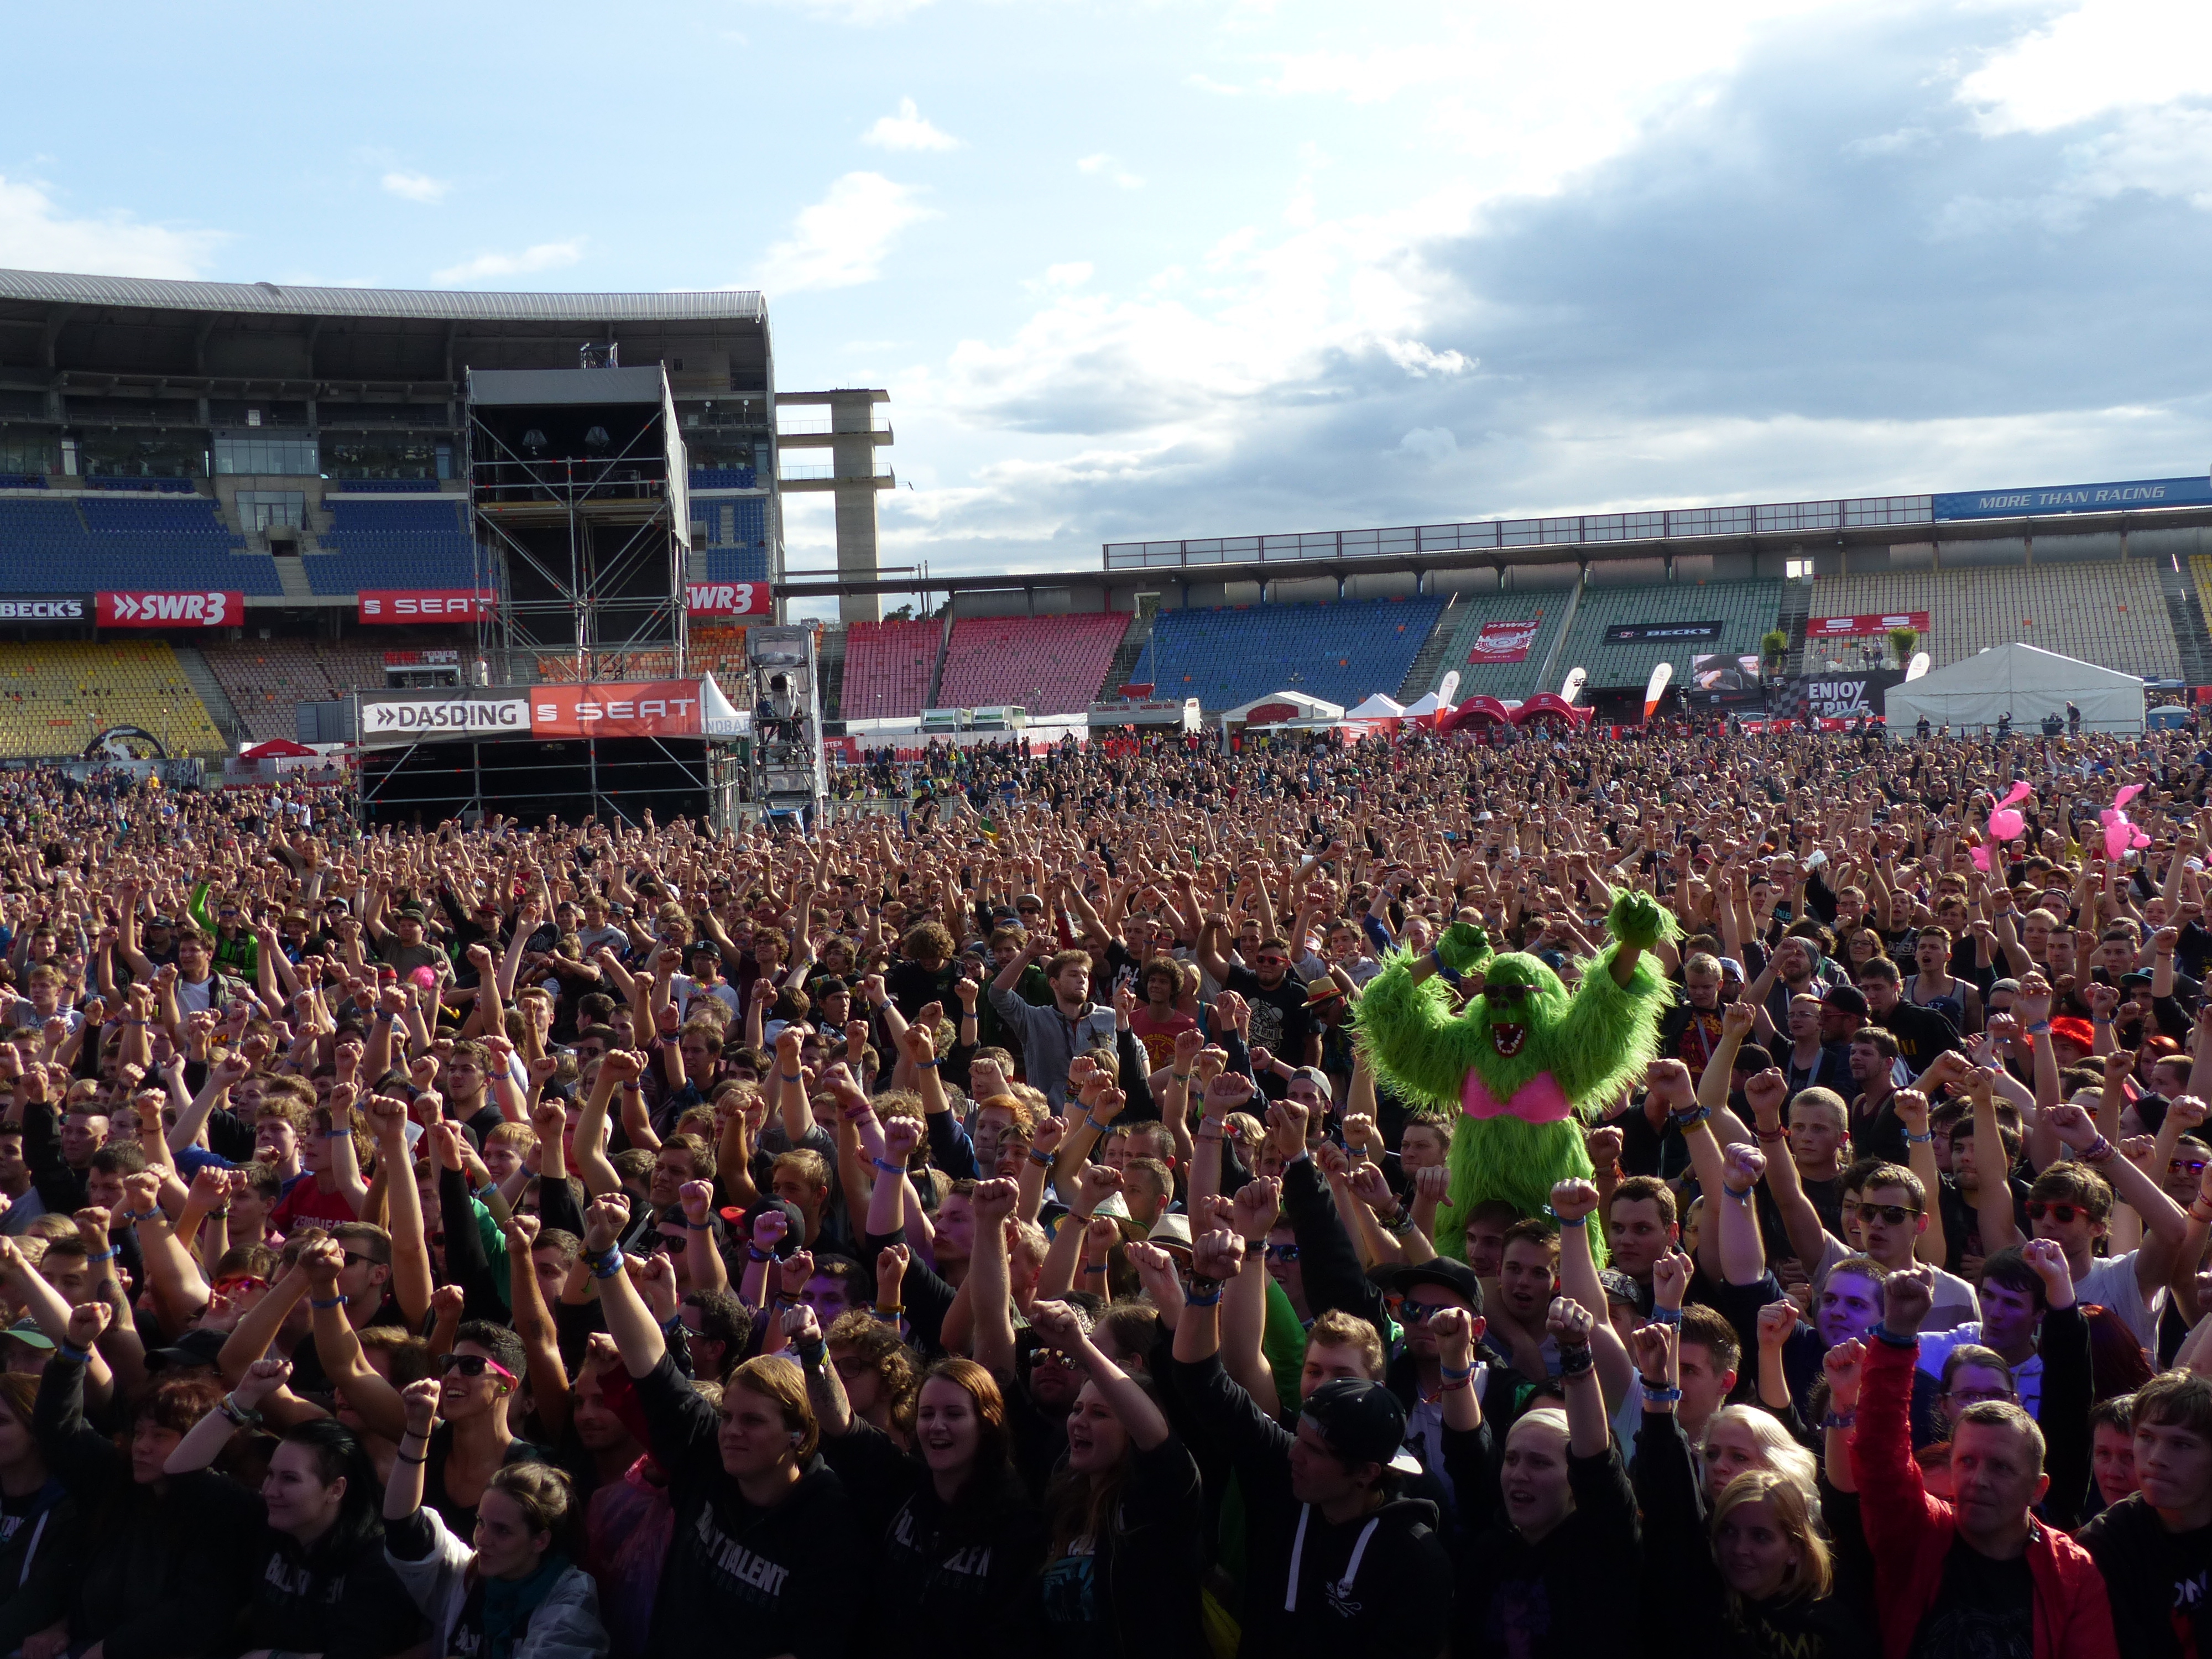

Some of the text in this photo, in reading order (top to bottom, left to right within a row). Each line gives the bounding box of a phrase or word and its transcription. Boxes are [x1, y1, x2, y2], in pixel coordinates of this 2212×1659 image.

[1979, 486, 2166, 509] MORE THAN RACING
[0, 599, 83, 618] BECK'S
[140, 593, 227, 625] SWR3
[394, 598, 492, 614] SEAT
[1809, 681, 1867, 702] ENJOY
[398, 704, 517, 727] DASDING
[575, 698, 696, 721] SEAT
[717, 1536, 790, 1597] TALENT
